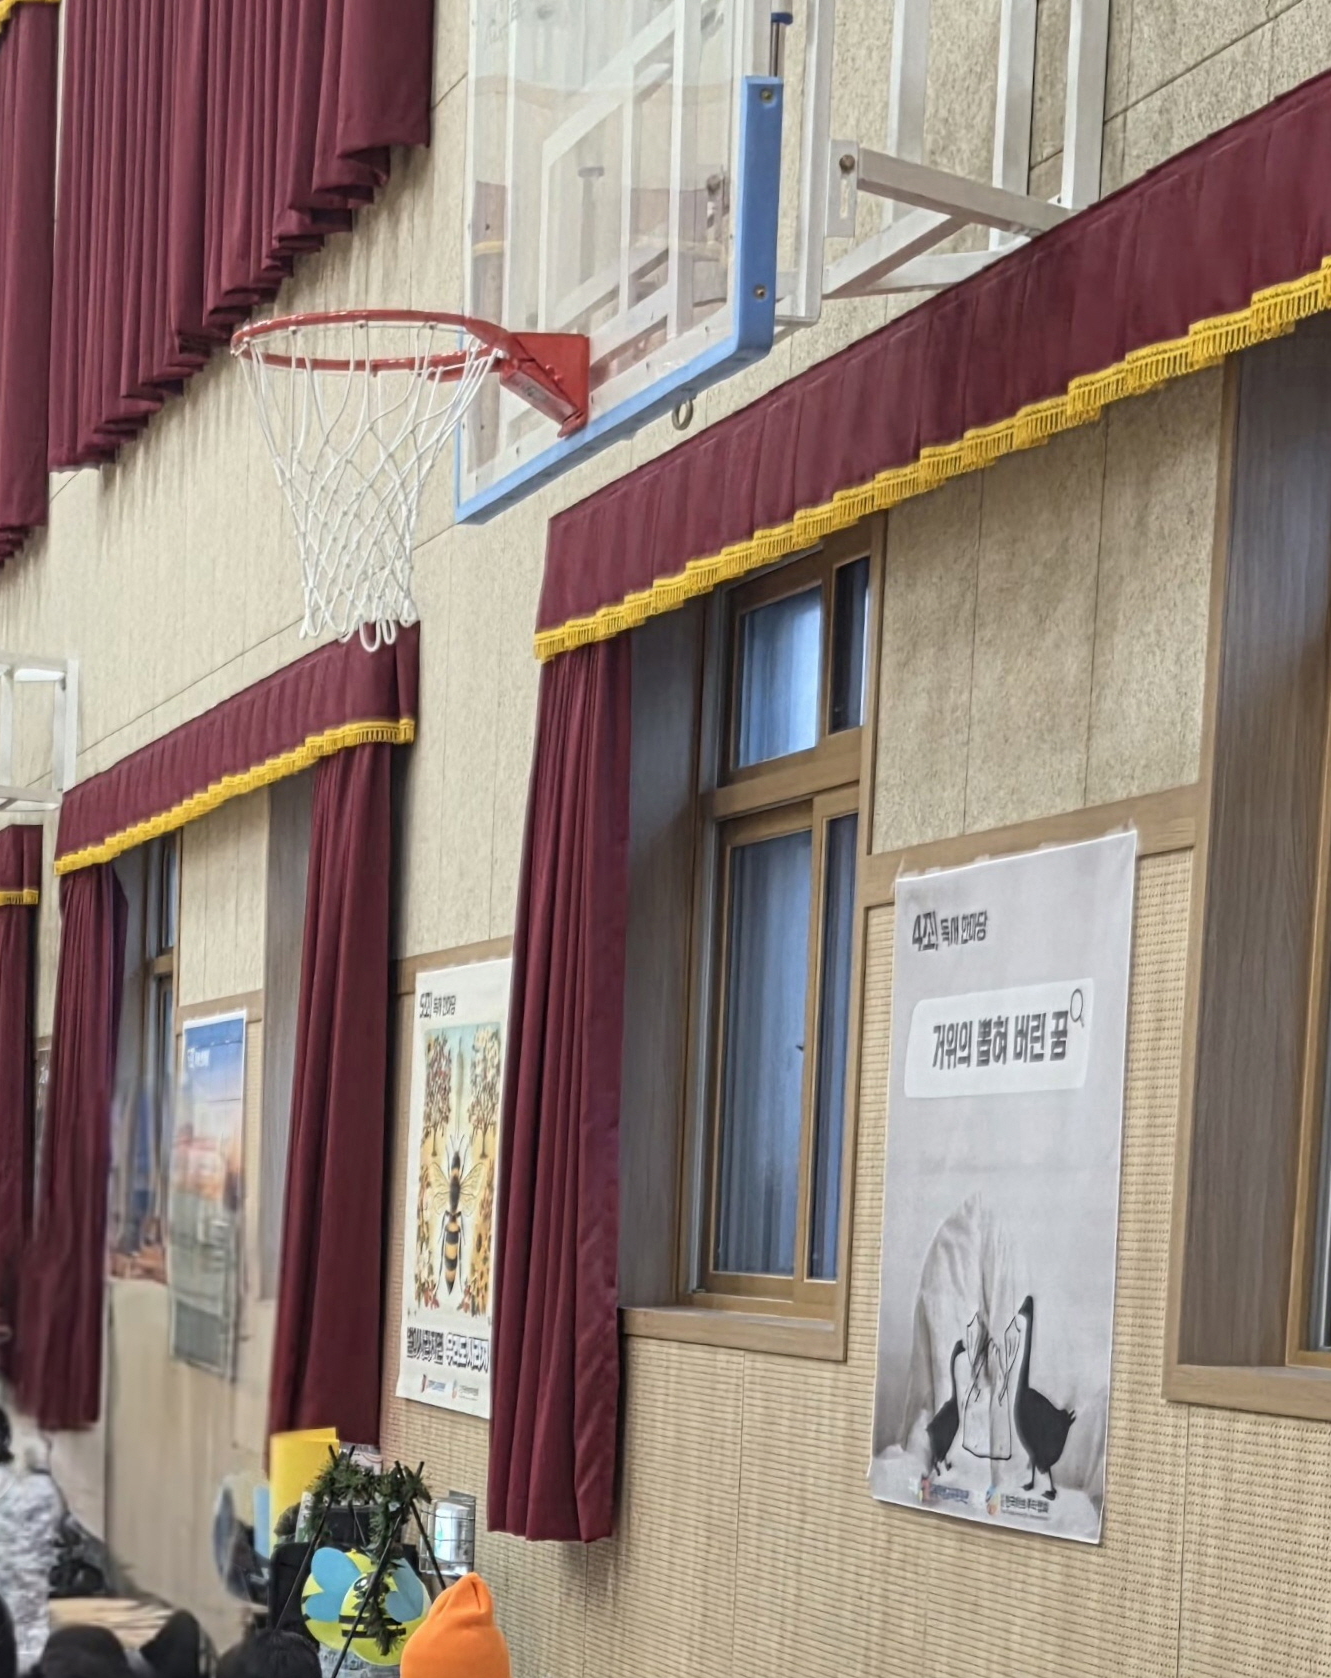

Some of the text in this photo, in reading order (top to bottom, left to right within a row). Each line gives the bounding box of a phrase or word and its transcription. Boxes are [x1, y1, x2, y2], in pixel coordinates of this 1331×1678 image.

[932, 1010, 1069, 1070] 거위의 뽑혀 버린 꿈
